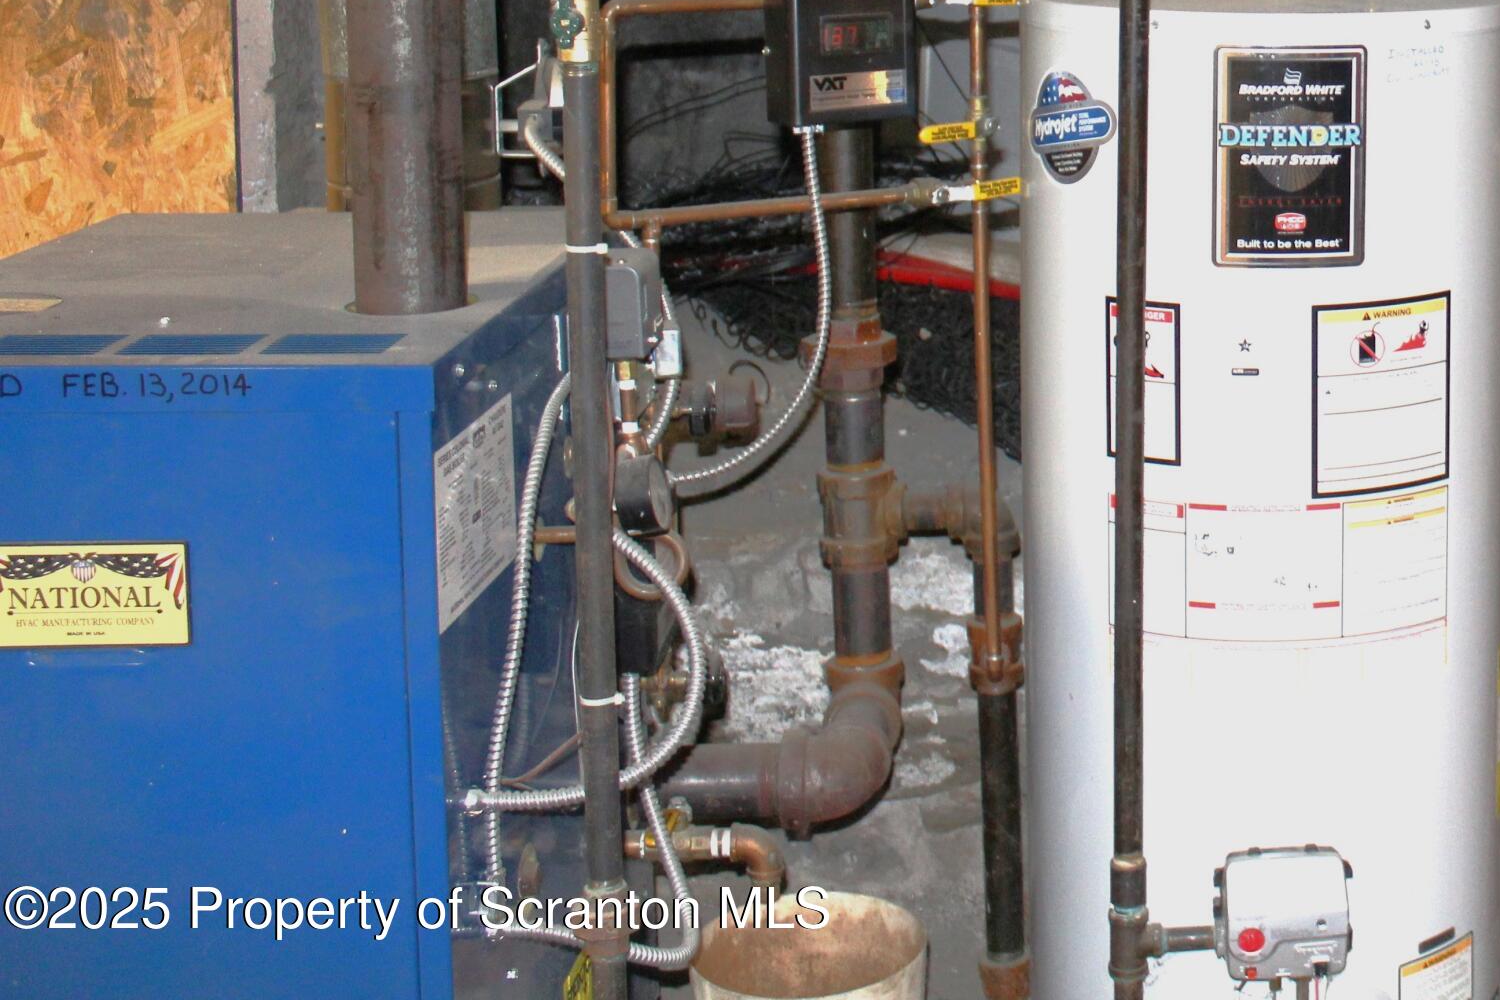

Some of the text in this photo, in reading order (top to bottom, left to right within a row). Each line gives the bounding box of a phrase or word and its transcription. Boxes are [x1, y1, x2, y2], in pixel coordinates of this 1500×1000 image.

[813, 76, 847, 91] VXT
[1239, 84, 1344, 95] BRADFORD WHITE
[1035, 114, 1077, 141] Hydrojet
[1219, 124, 1361, 147] DEFENDER
[1239, 154, 1341, 165] SAFETY SYSTEM
[1236, 239, 1261, 249] Built
[1263, 240, 1275, 249] to
[1277, 239, 1292, 249] be
[1294, 239, 1312, 249] the
[1373, 308, 1412, 319] WARNING
[62, 372, 127, 398] FEB.
[180, 372, 252, 395] 2014
[7, 586, 162, 609] NATIONAL
[16, 617, 155, 628] HVAC MANUFACTURING COMPANY
